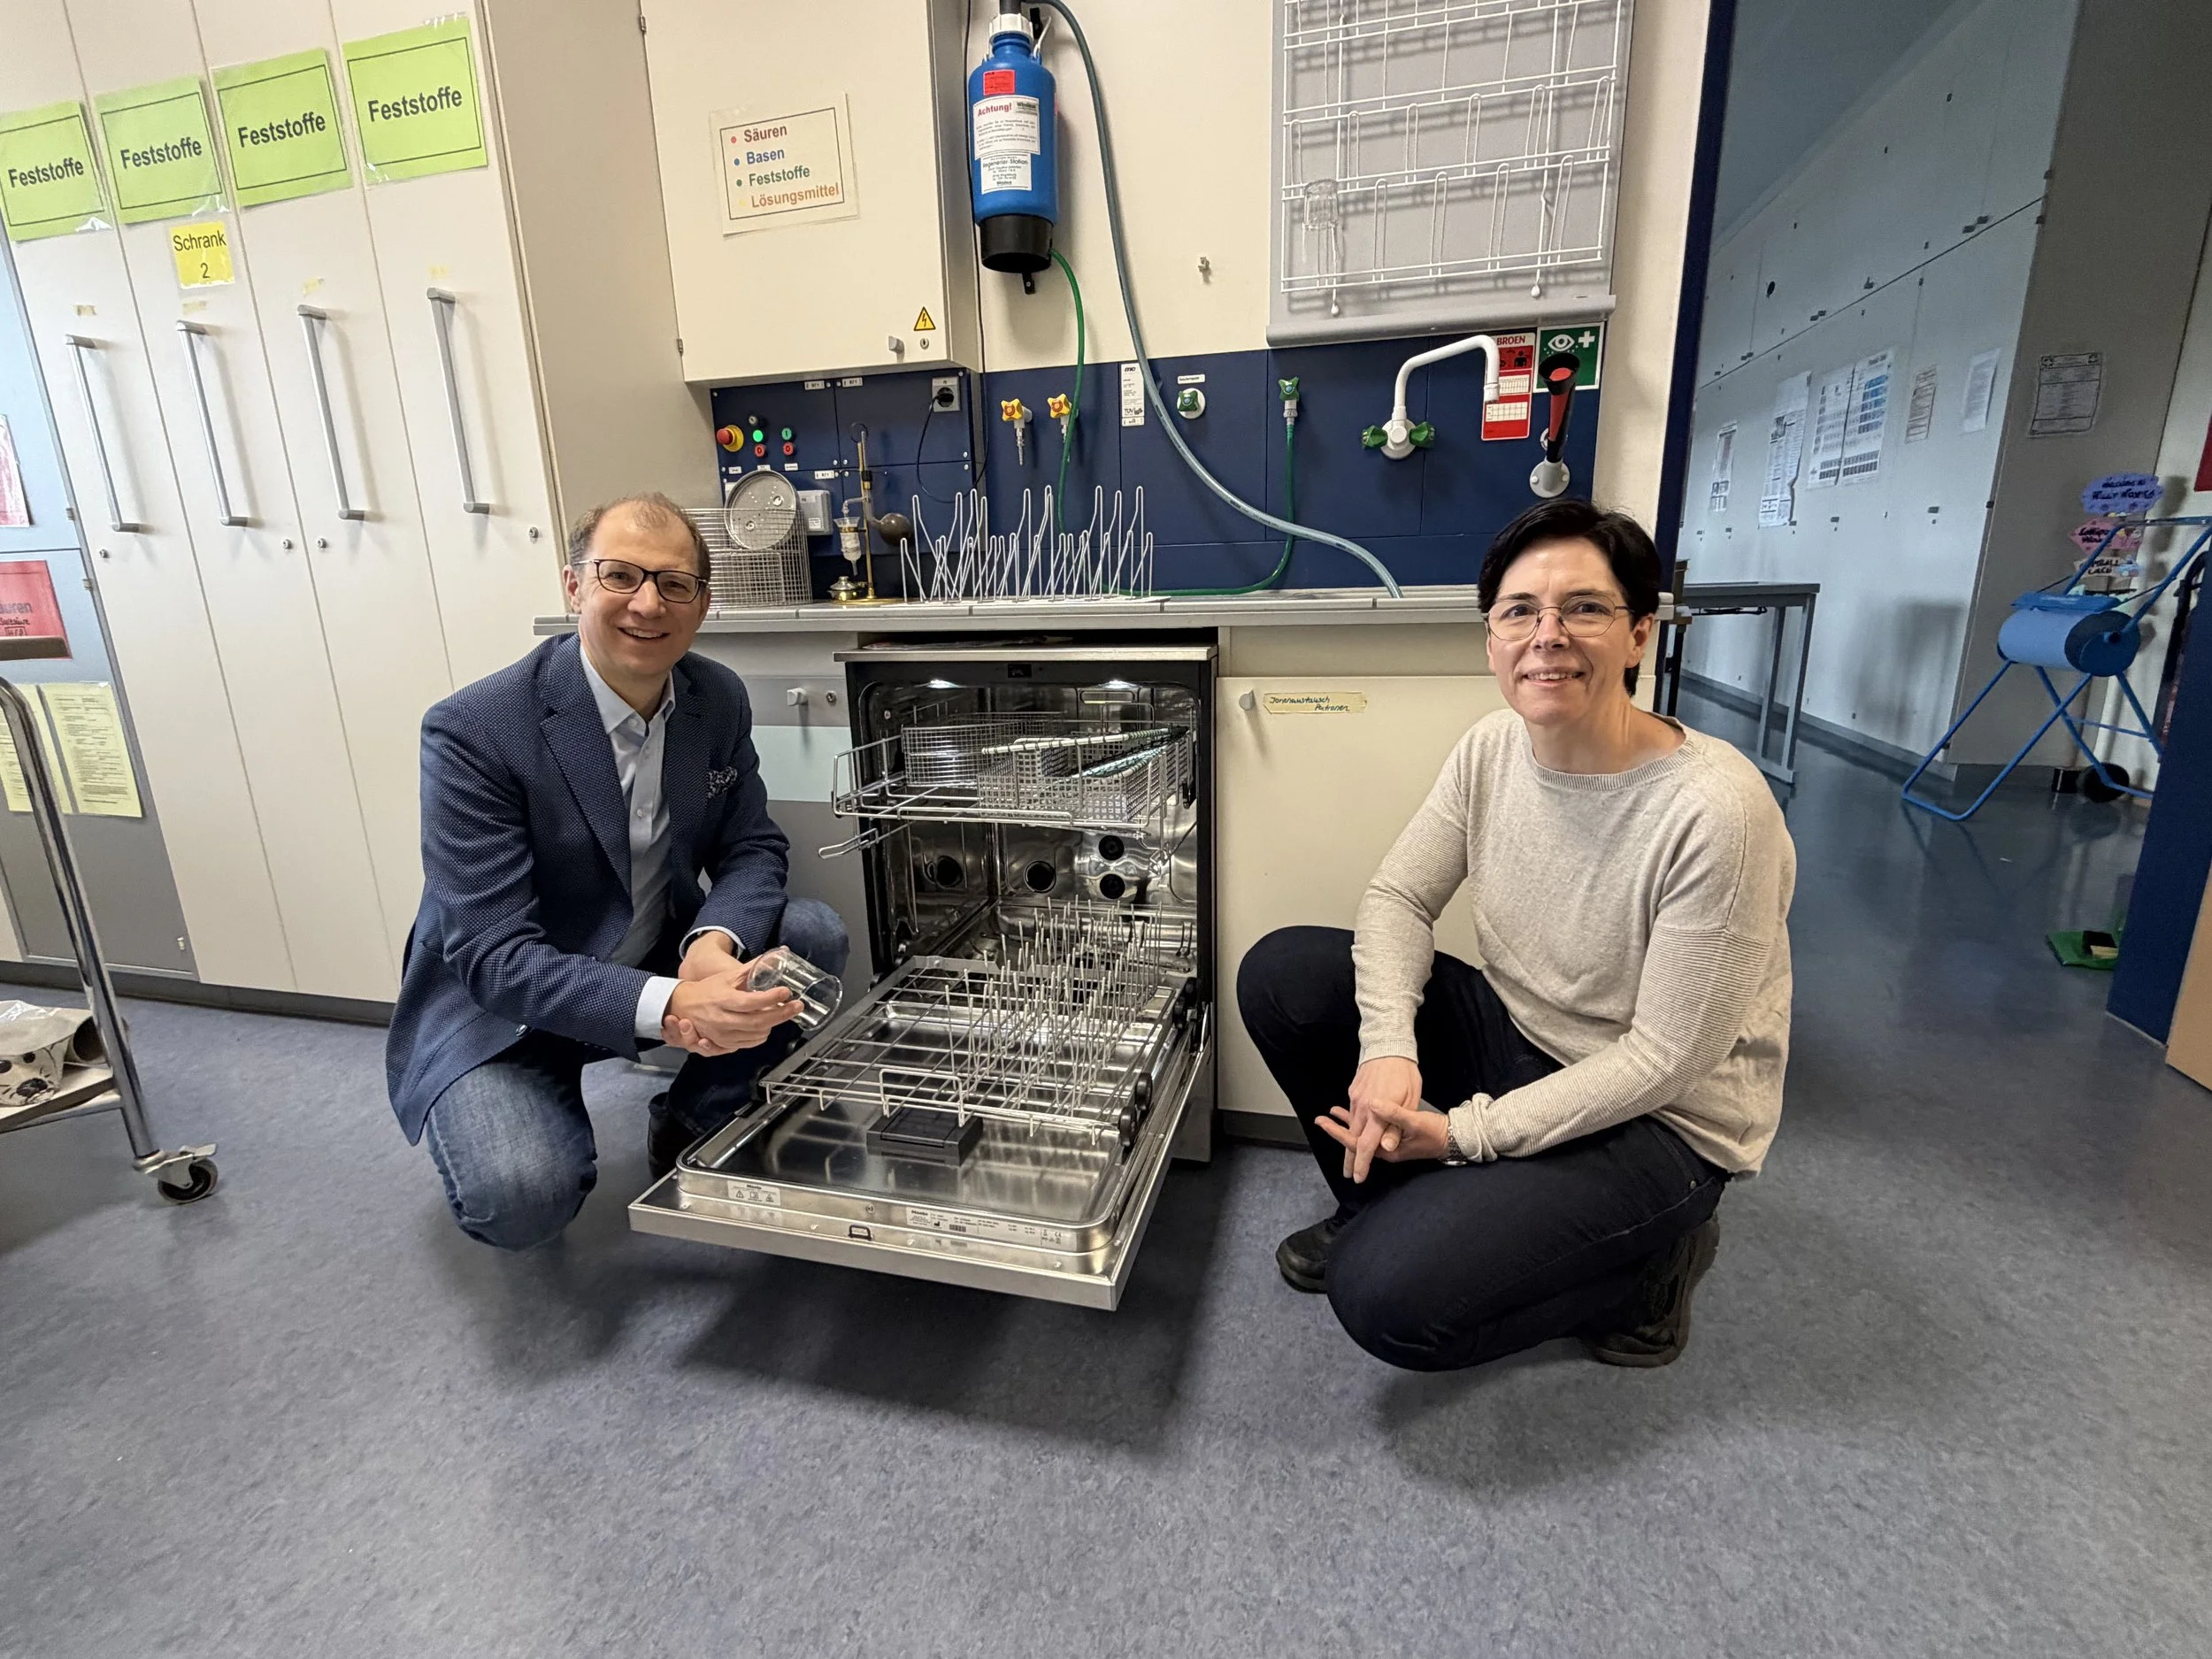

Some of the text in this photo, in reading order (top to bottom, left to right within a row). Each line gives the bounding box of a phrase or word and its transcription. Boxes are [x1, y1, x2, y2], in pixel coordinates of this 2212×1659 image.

[367, 86, 463, 122] Feststoffe
[977, 102, 1012, 118] Achtung!
[237, 111, 326, 149] Feststoffe
[744, 125, 787, 143] Säuren
[120, 136, 203, 170] Feststoffe
[746, 149, 785, 165] Basen
[8, 157, 84, 188] Feststoffe
[749, 165, 810, 187] Feststoffe
[751, 182, 840, 209] Lösungsmittel
[173, 229, 227, 252] Schrank
[200, 262, 211, 280] 2
[1497, 335, 1525, 346] BROEN
